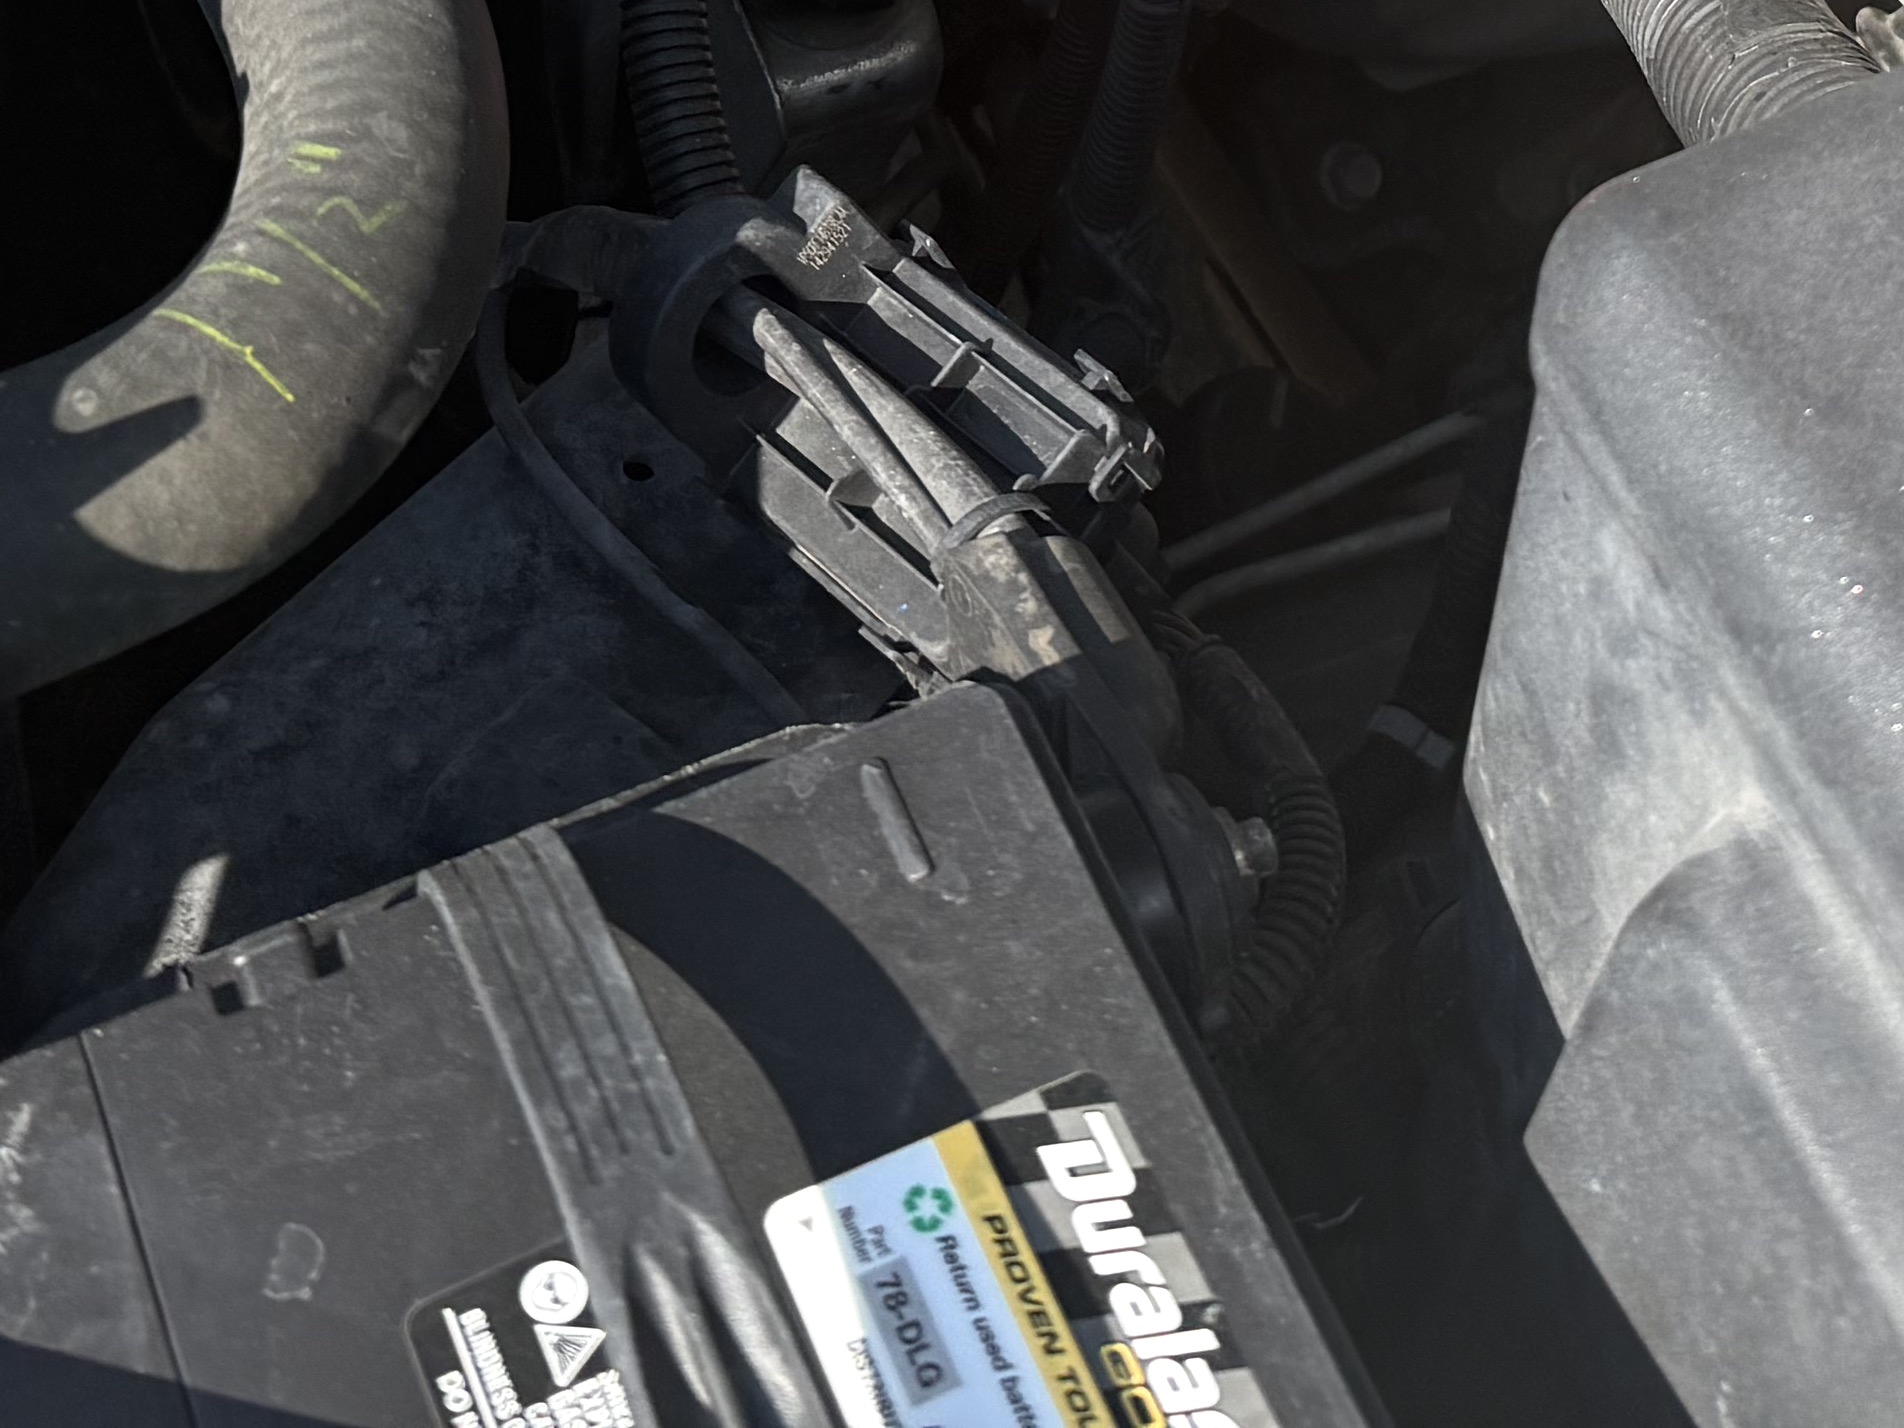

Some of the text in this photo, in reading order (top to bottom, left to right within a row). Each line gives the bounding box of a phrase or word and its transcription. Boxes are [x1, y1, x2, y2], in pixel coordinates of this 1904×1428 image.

[839, 1206, 873, 1264] Number
[867, 1224, 893, 1257] Part
[982, 1213, 1068, 1356] PROVEN
[875, 1271, 943, 1389] 78-DLG
[934, 1234, 982, 1312] Return
[972, 1316, 1015, 1372] used
[436, 1370, 474, 1414] DO
[458, 1307, 524, 1421] BLINDNESS
